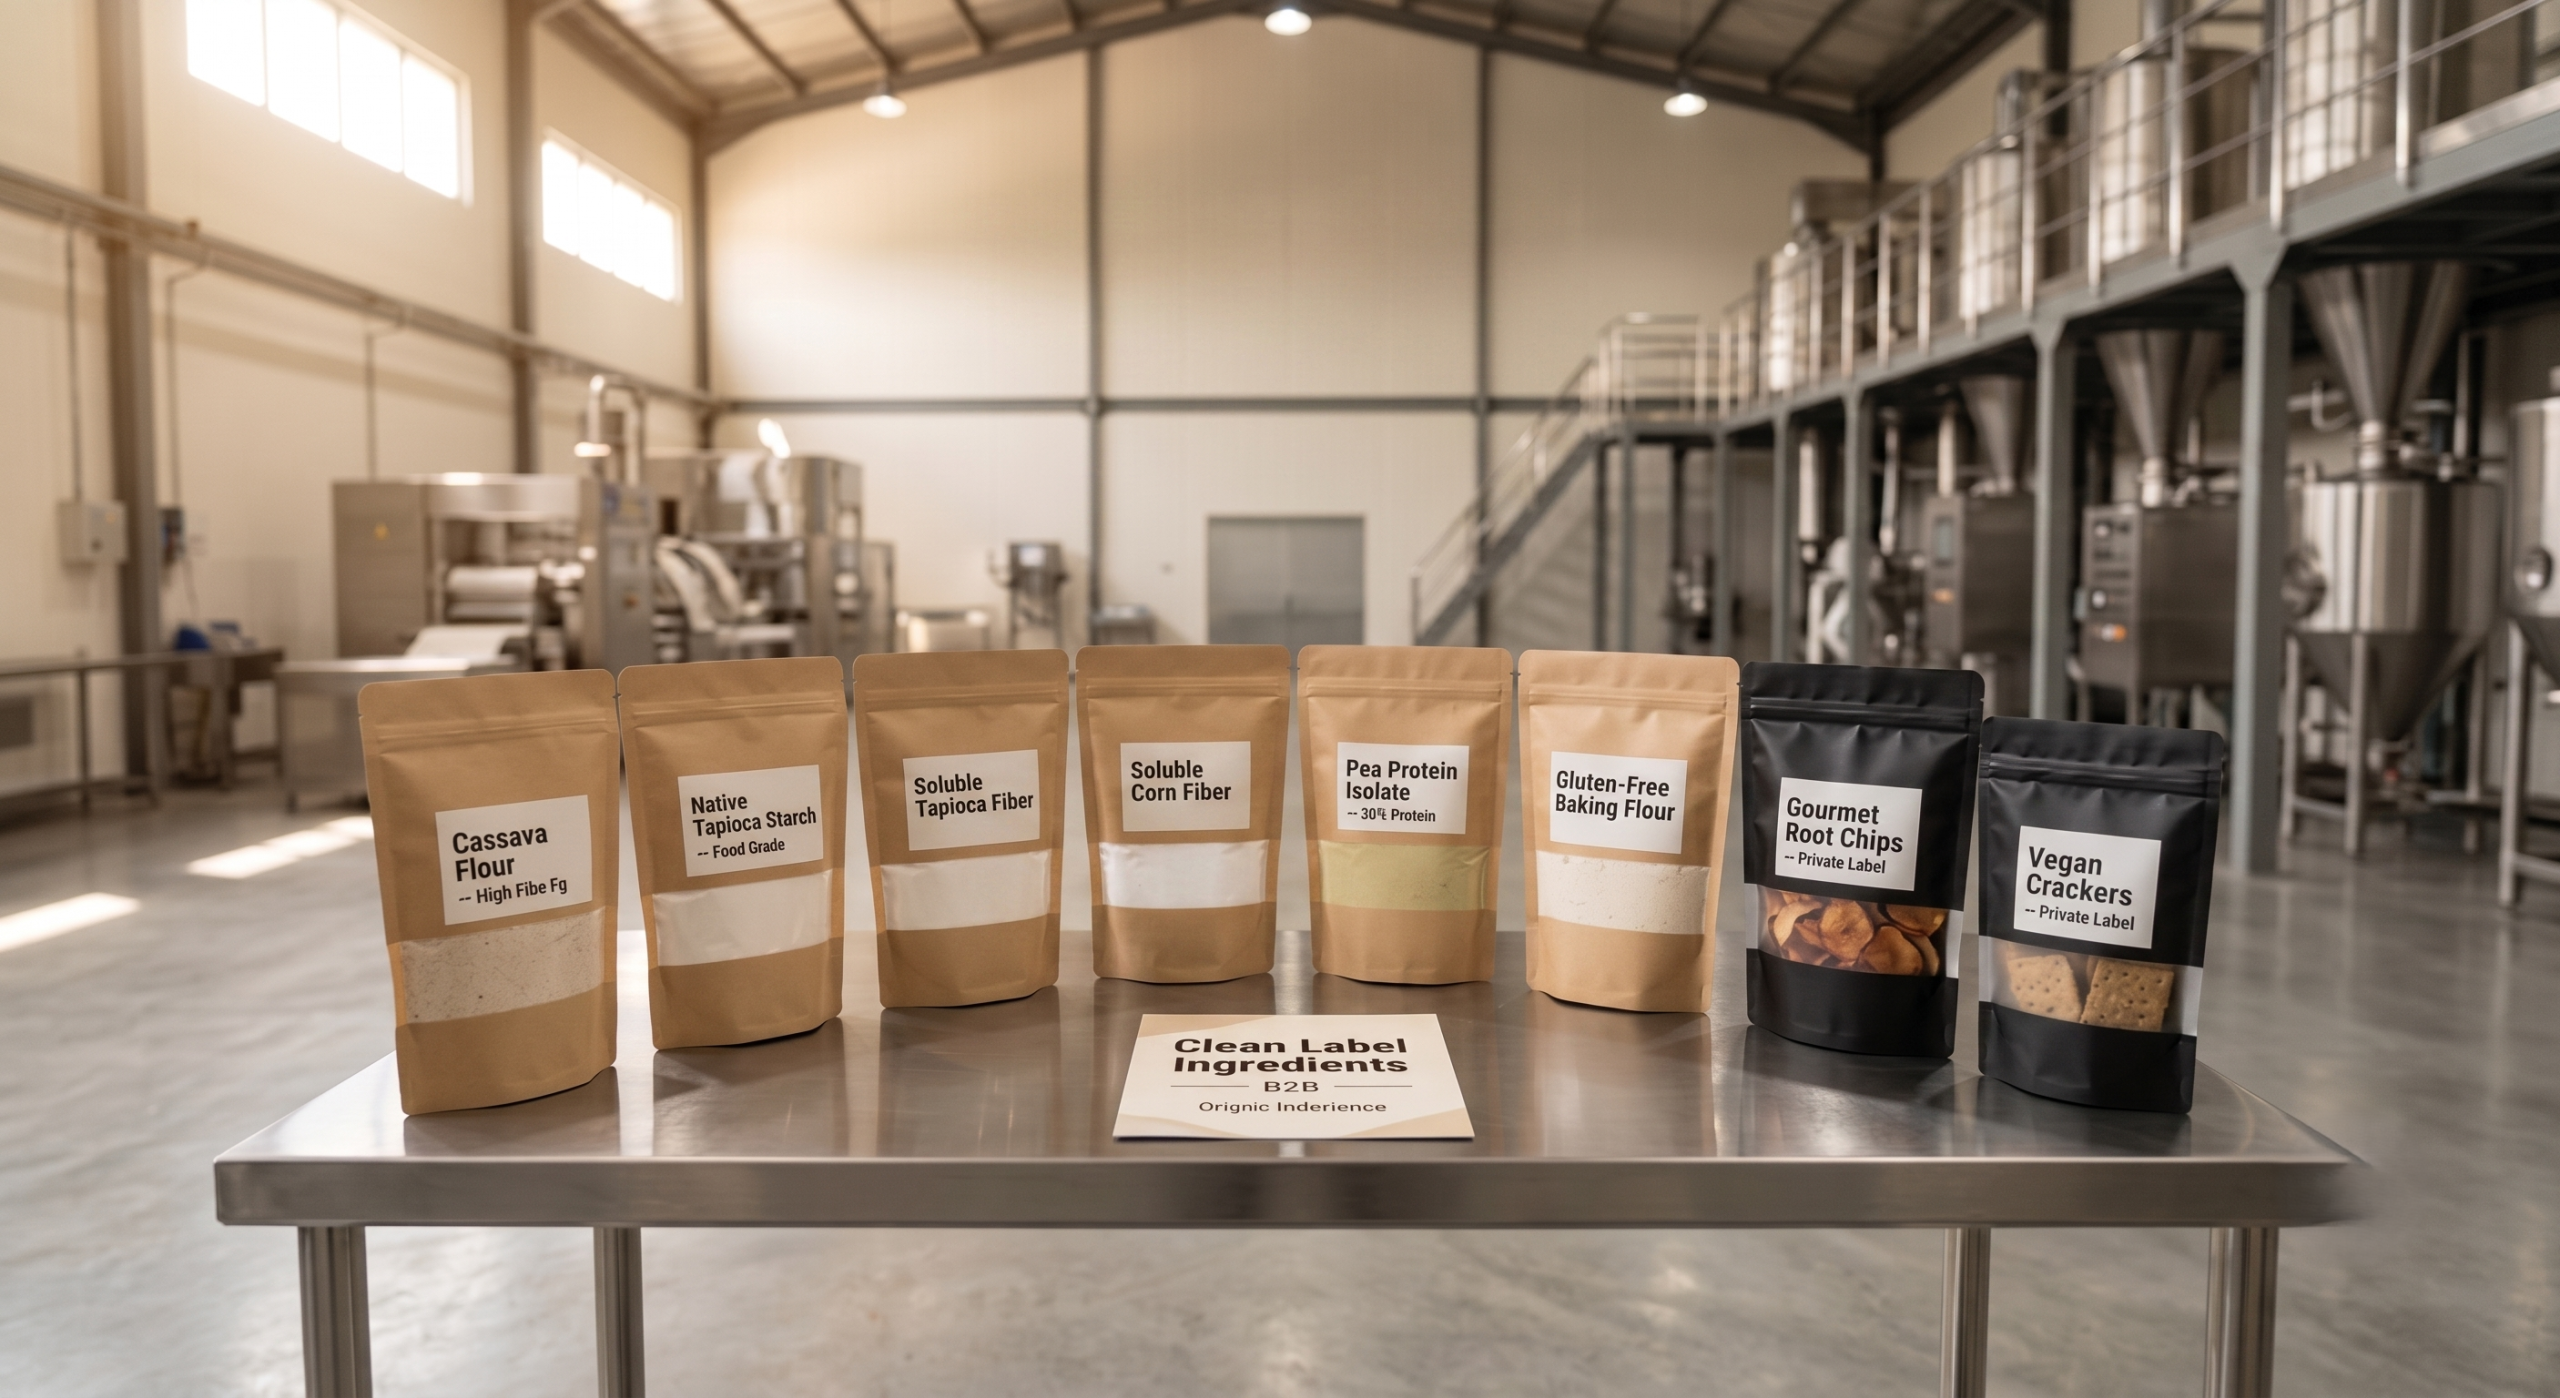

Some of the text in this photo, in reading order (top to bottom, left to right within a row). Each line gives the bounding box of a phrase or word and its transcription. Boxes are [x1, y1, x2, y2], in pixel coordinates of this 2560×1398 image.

[1131, 760, 1203, 779] Soluble
[1346, 759, 1458, 780] Pea Protein
[914, 773, 983, 795] Soluble
[1131, 783, 1231, 802] Corn Fiber
[1346, 782, 1410, 800] Isolate
[1556, 770, 1670, 796] Gluten-Free
[690, 793, 748, 814] Native
[915, 793, 1033, 820] Tapioca Fiber
[1555, 794, 1675, 821] Baking Flour
[1786, 796, 1879, 825] Gourmet
[692, 806, 817, 838] Tapioca Starch
[1391, 809, 1436, 822] Protein
[452, 824, 548, 854] Cassava
[712, 843, 746, 859] Food
[749, 838, 785, 854] Grade
[1785, 823, 1904, 856] Root Chips
[455, 855, 515, 882] Flour
[1798, 852, 1845, 869] Private
[1848, 857, 1886, 874] Label
[2029, 846, 2102, 876] Vegan
[476, 885, 512, 906] High
[516, 880, 547, 898] Fibe
[550, 878, 567, 896] Fg
[2026, 873, 2132, 906] Crackers
[2039, 905, 2090, 926] Private
[2092, 912, 2135, 931] Label
[1174, 1039, 1407, 1053] Clean Label
[1174, 1057, 1408, 1076] Ingredients
[1264, 1081, 1319, 1092] B2B
[1199, 1101, 1387, 1114] Orignic Inderience
